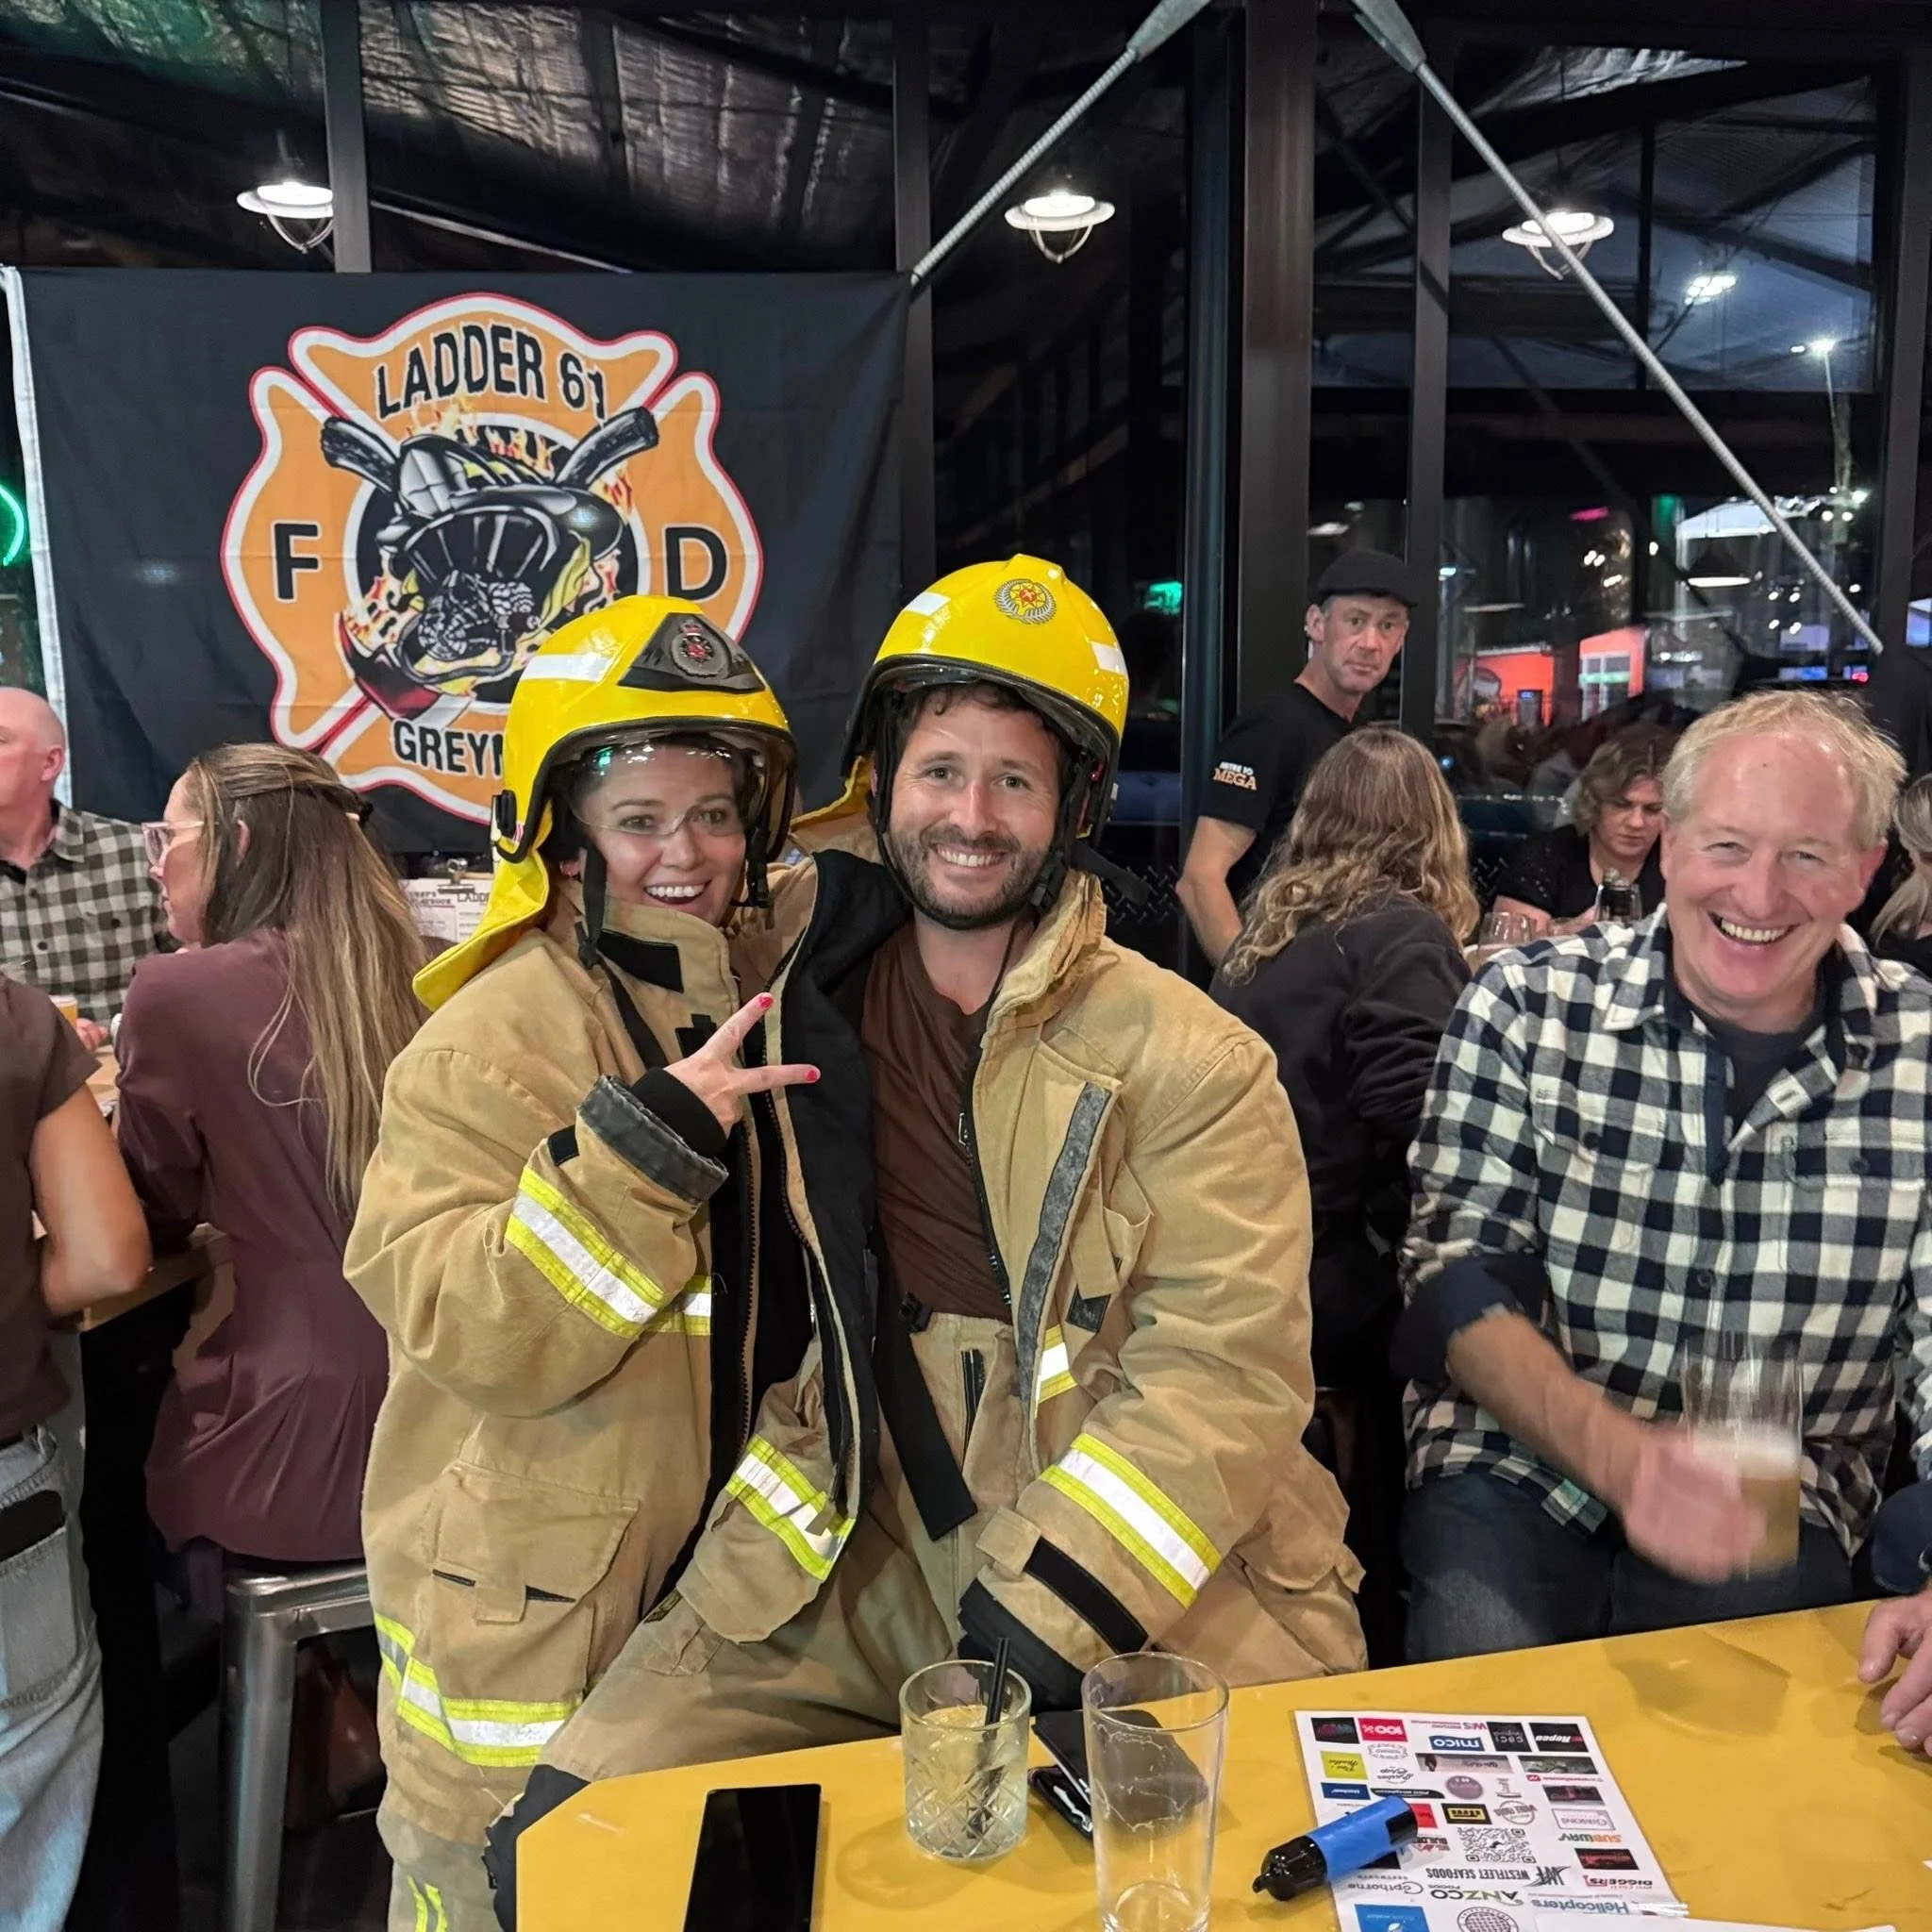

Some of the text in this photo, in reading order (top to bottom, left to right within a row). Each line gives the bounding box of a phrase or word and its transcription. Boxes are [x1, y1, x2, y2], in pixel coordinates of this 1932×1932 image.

[376, 325, 608, 421] LADDER 61
[274, 523, 727, 601] F D
[1212, 767, 1257, 791] MEGA
[1361, 1724, 1404, 1736] 100%
[1433, 1739, 1480, 1748] mico
[1535, 1734, 1572, 1743] Repco
[1557, 1833, 1623, 1843] SUBWAY
[1425, 1868, 1531, 1880] WESTFLEET SEAFOODS
[1348, 1881, 1424, 1895] Copthorne
[1429, 1890, 1518, 1901] ANZCO
[1531, 1899, 1629, 1915] Helicopters
